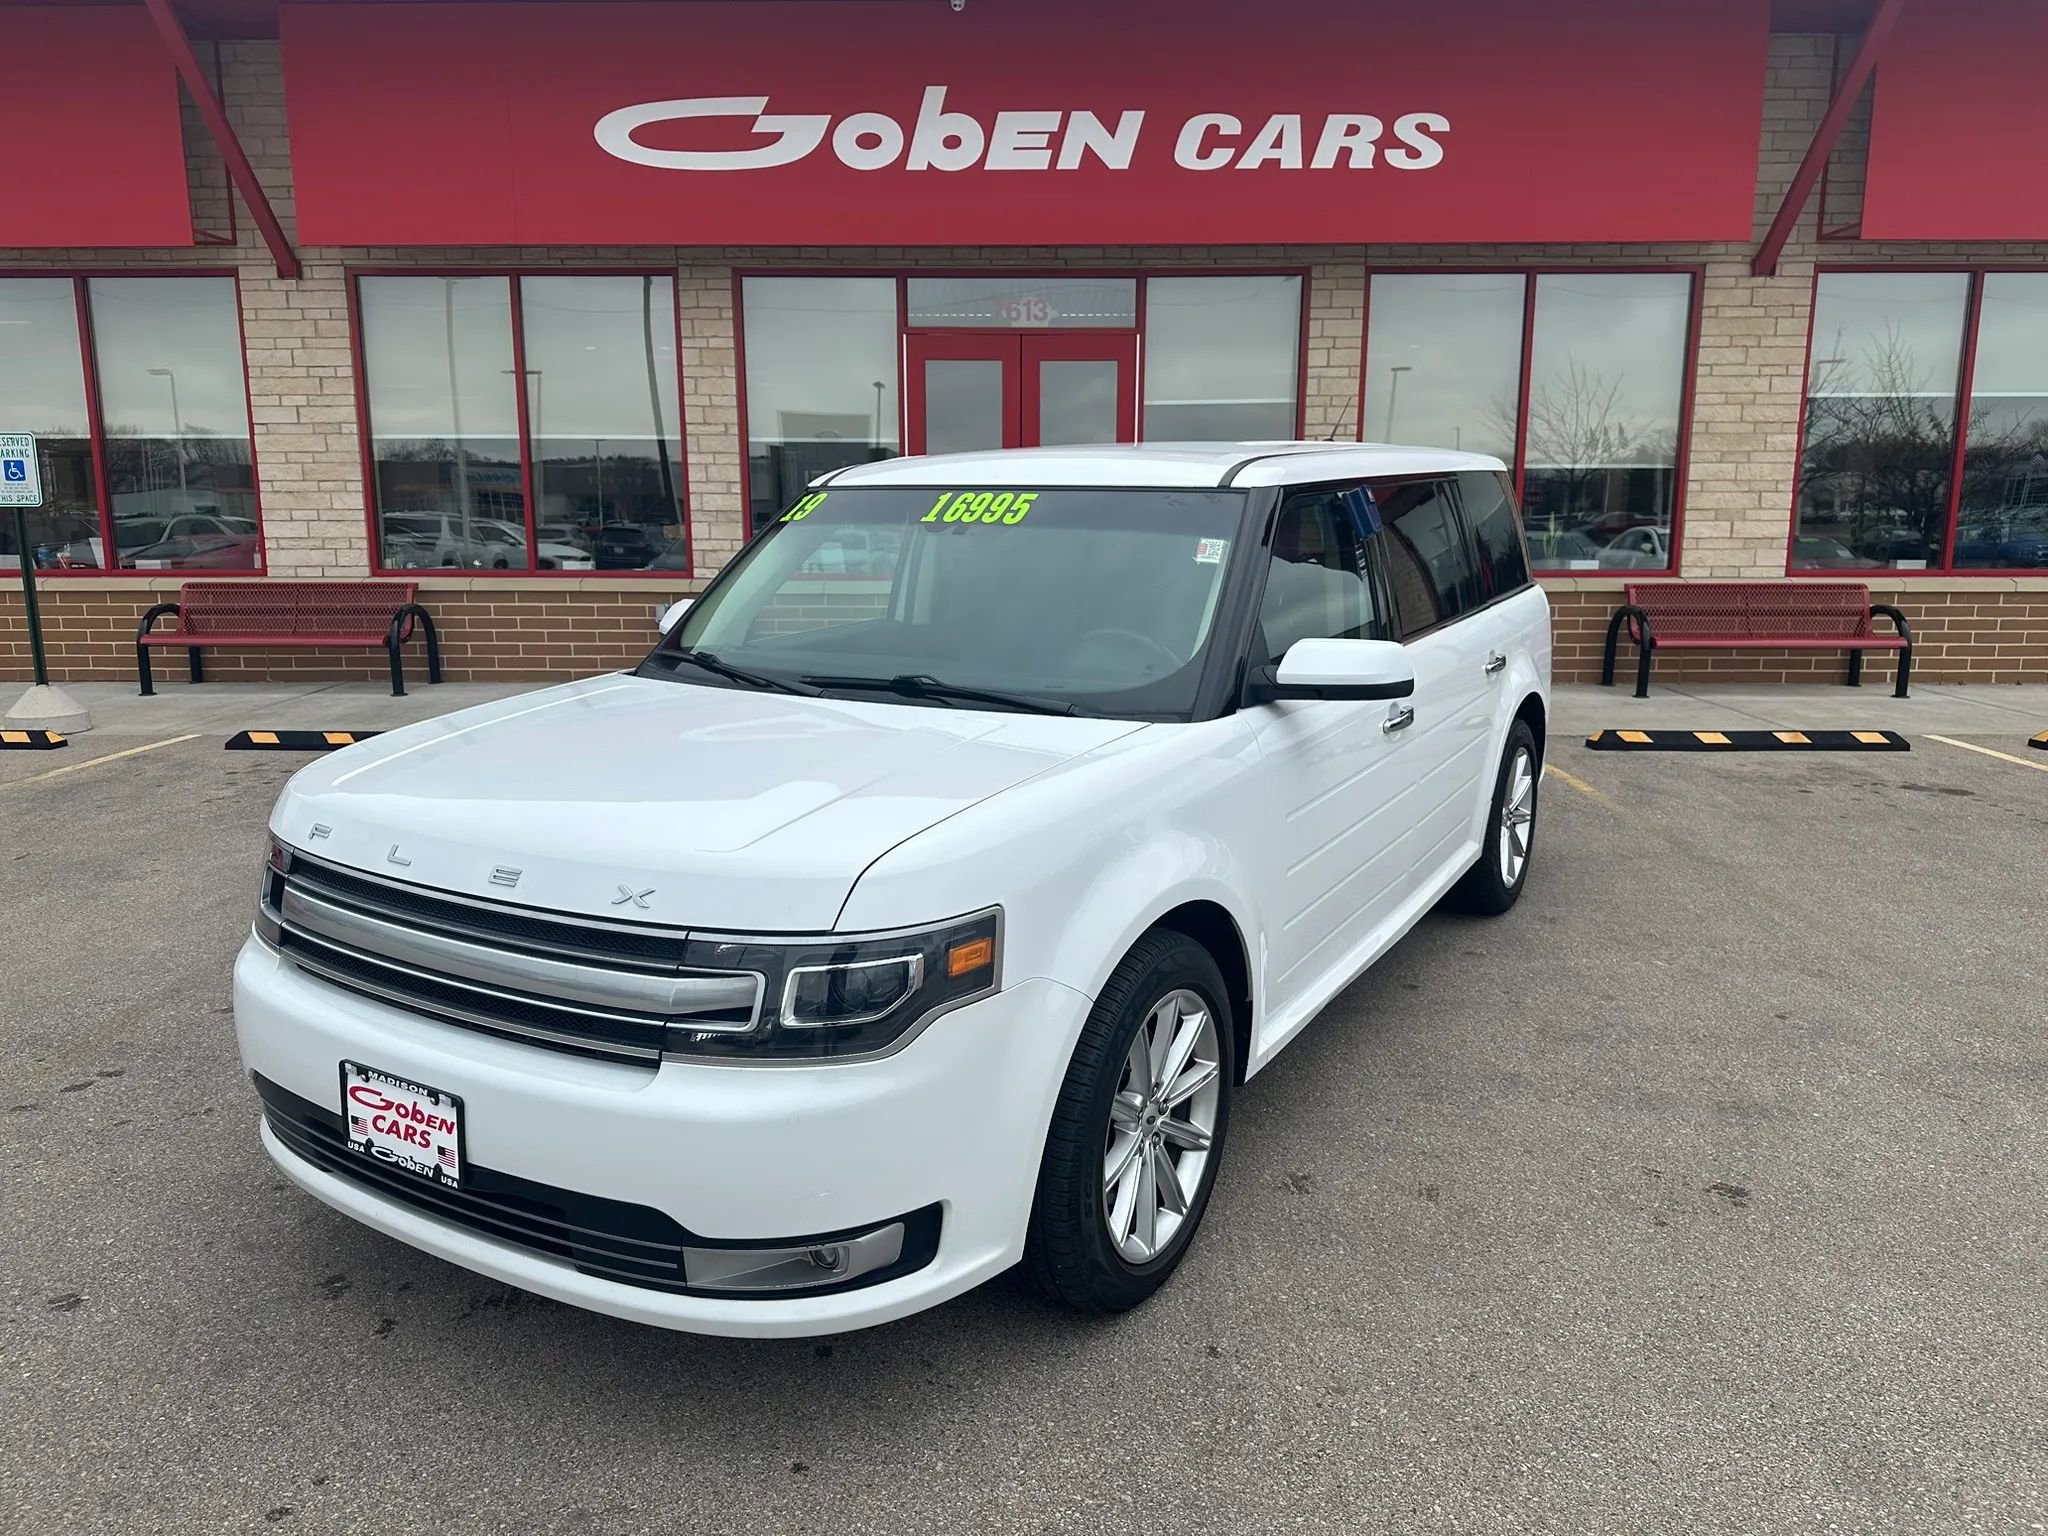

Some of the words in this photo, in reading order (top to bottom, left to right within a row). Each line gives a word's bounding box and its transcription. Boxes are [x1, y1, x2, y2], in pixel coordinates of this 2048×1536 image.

[1174, 112, 1451, 170] CARS
[0, 437, 30, 447] SERVED
[0, 448, 30, 458] ARKING
[17, 494, 38, 503] SPACE
[779, 492, 828, 522] 19
[920, 492, 1039, 525] 16995
[308, 822, 656, 909] FLEX
[367, 1071, 429, 1097] MADISON
[371, 1114, 432, 1149] CARS
[347, 1140, 365, 1153] USA
[440, 1175, 459, 1189] USA
